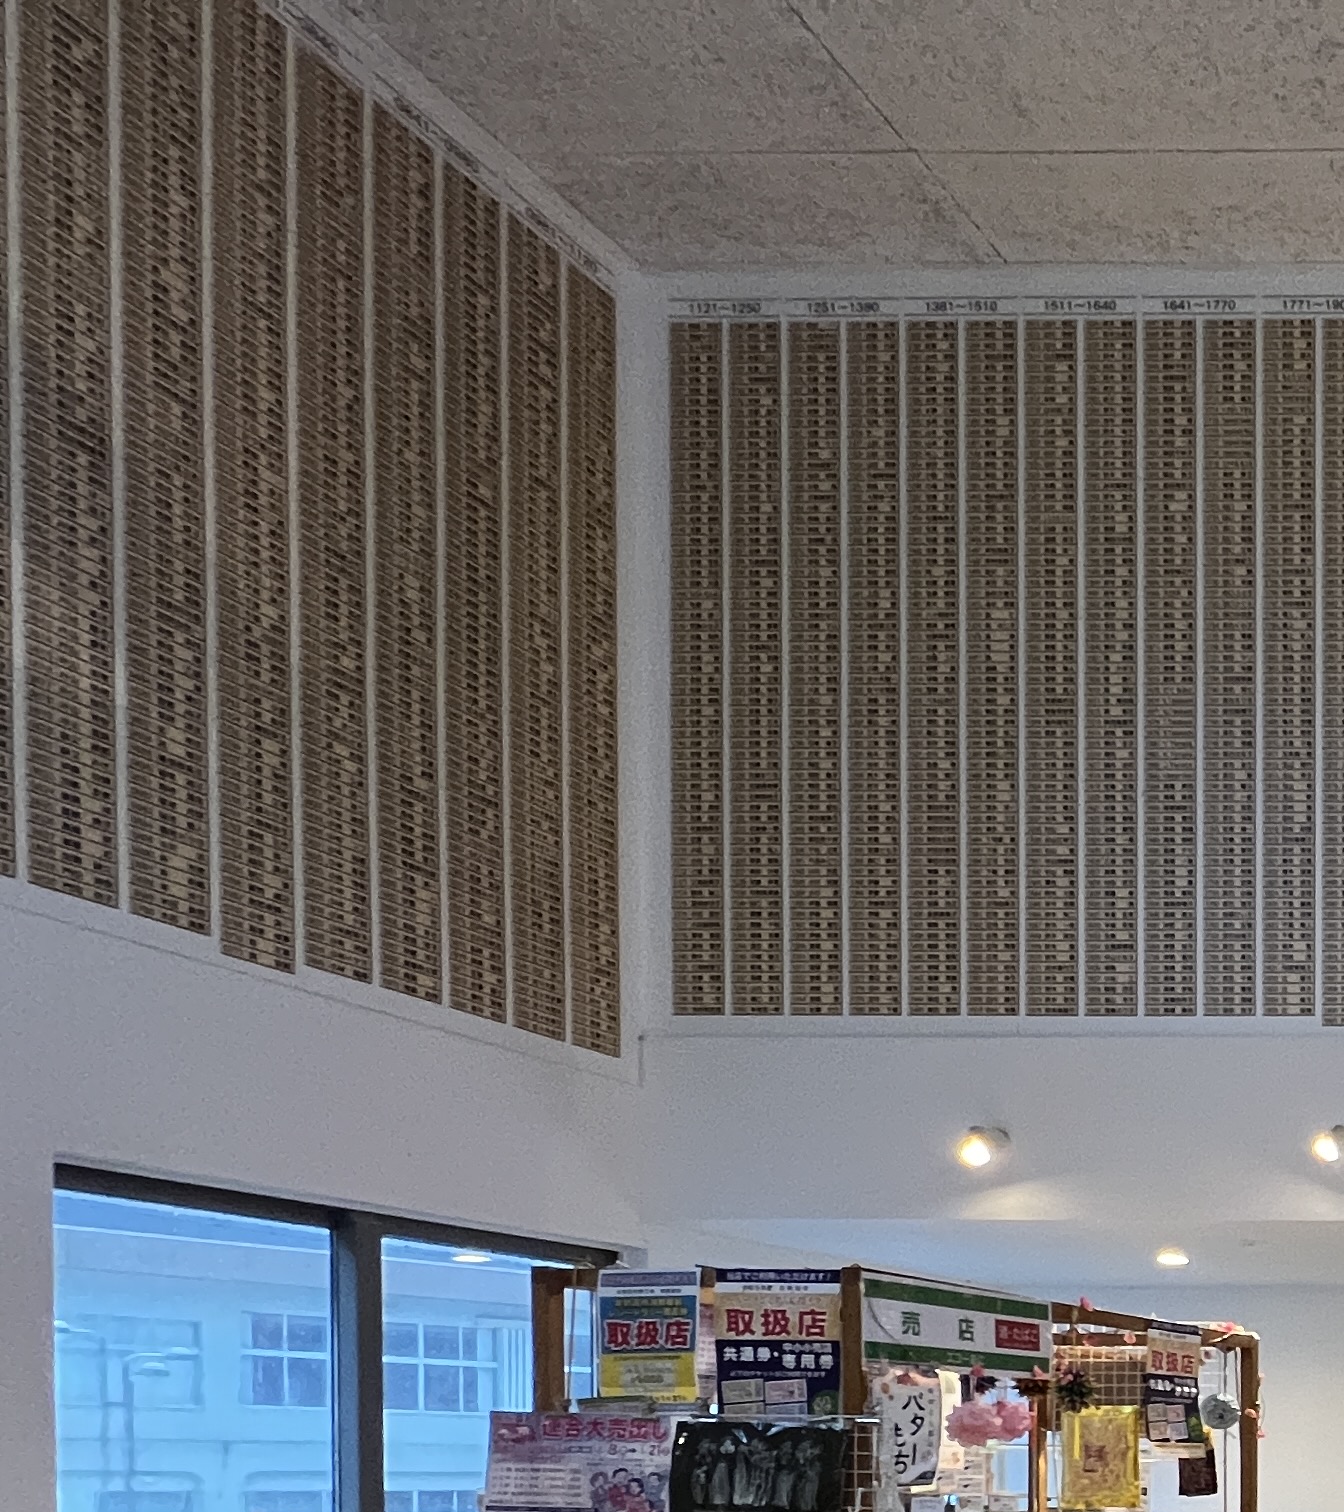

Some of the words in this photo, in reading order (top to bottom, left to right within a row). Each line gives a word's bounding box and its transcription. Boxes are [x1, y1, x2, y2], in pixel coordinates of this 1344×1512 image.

[606, 1320, 692, 1348] 取扱店
[725, 1309, 827, 1337] 取扱店
[901, 1311, 975, 1342] 売店
[1150, 1349, 1195, 1375] 取扱店
[901, 1391, 925, 1466] バター
